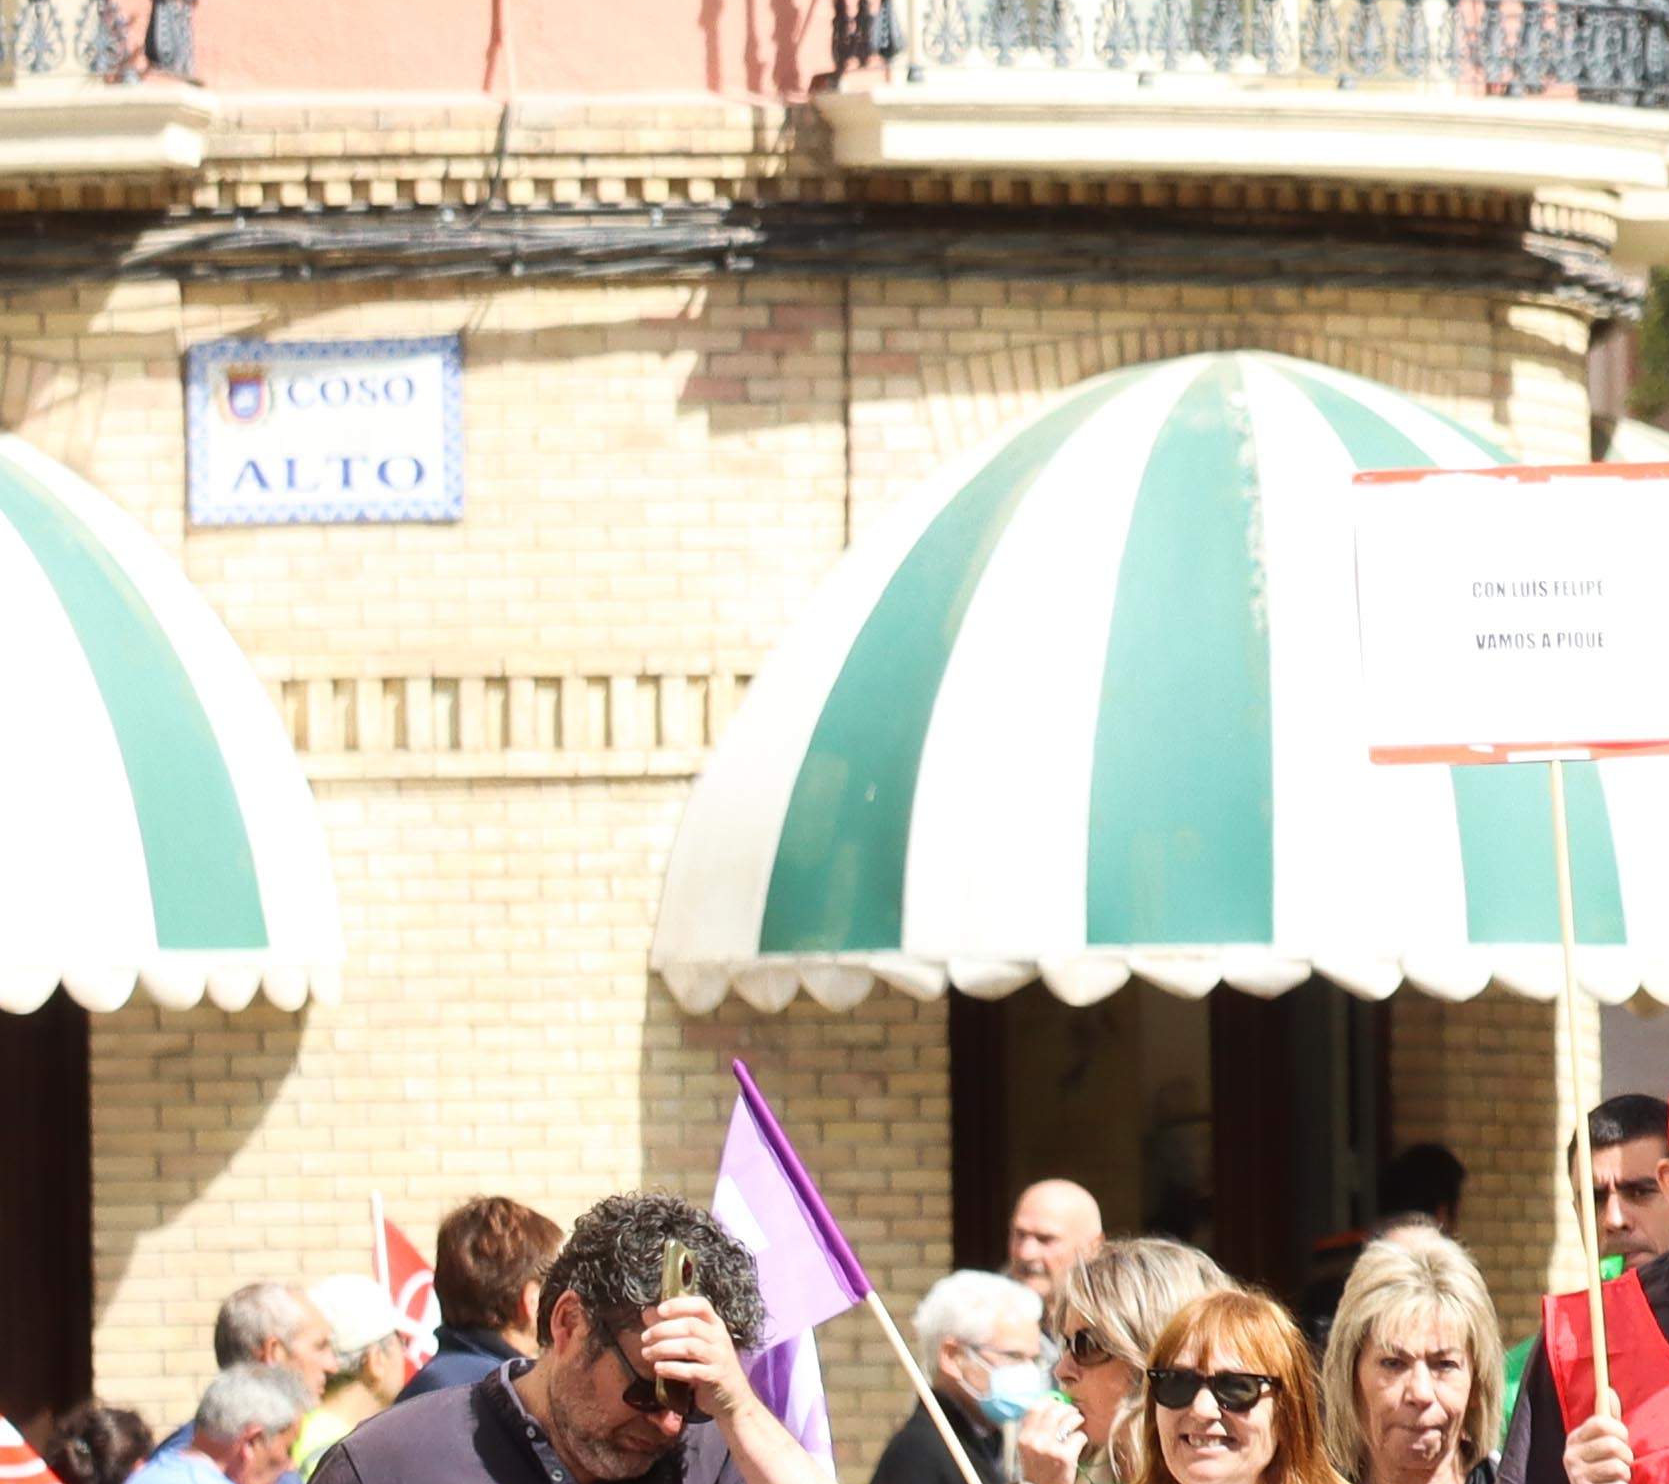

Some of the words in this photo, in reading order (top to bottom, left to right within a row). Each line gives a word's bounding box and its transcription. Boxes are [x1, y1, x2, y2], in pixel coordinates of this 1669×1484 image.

[286, 374, 417, 409] COSO
[231, 454, 427, 494] ALTO
[1472, 580, 1506, 598] CON
[1475, 632, 1537, 650] VAMOS
[1541, 632, 1552, 649] A
